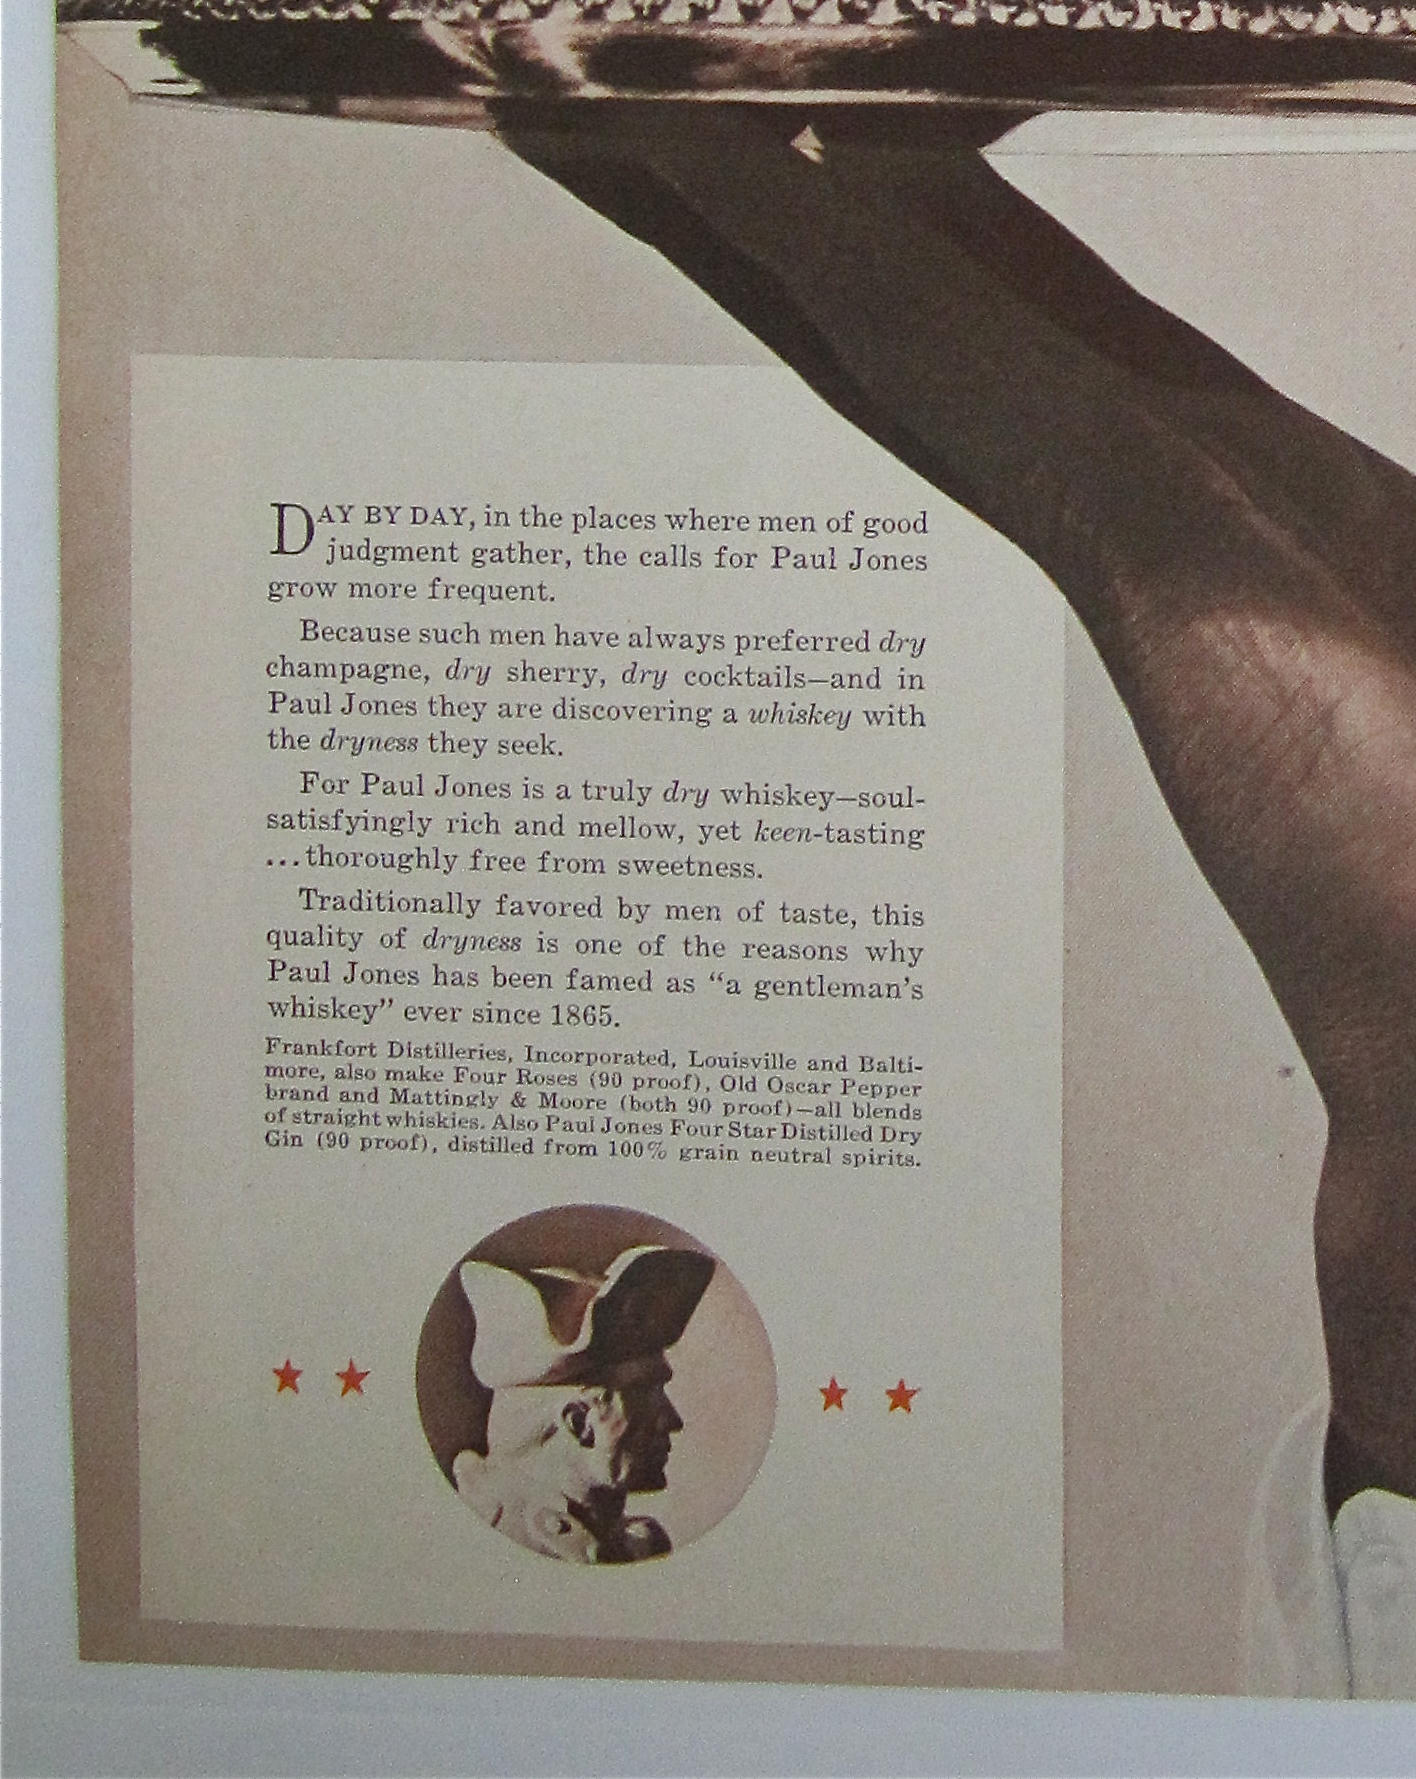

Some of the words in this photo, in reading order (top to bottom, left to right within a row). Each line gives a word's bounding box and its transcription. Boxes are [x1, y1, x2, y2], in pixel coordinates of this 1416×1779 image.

[270, 503, 354, 555] DAY
[365, 506, 402, 524] BY
[410, 506, 475, 531] DAY,
[484, 504, 510, 527] in
[520, 504, 563, 528] the
[572, 506, 656, 534] places
[664, 508, 750, 531] where
[759, 516, 816, 532] men
[826, 510, 855, 533] of
[863, 510, 928, 539] good
[326, 537, 459, 566] judgment
[471, 541, 571, 569] gather,
[584, 542, 627, 566] the
[639, 544, 702, 568] calls
[715, 545, 758, 568] for
[771, 546, 837, 570] Paul
[849, 547, 927, 571] Jones
[268, 582, 337, 603] grow
[348, 582, 416, 598] more
[428, 577, 555, 605] frequent.
[300, 619, 410, 643] Because
[419, 622, 480, 644] such
[490, 629, 545, 645] men
[554, 623, 619, 647] have
[628, 626, 725, 654] always
[735, 629, 870, 656] preferred
[879, 630, 926, 658] dry
[266, 654, 430, 684] champagne,
[445, 657, 491, 686] dry
[507, 659, 605, 689] sherry,
[622, 661, 667, 690] dry
[898, 667, 925, 690] in
[268, 691, 331, 715] Paul
[340, 692, 417, 716] Jones
[428, 694, 487, 722] they
[498, 703, 542, 718] are
[553, 697, 712, 728] discovering
[723, 708, 738, 723] a
[749, 701, 852, 731] whiskey
[863, 704, 926, 727] with
[267, 727, 310, 750] the
[320, 727, 418, 756] dryness
[428, 731, 488, 759] they
[498, 733, 563, 756] seek.
[300, 771, 350, 794] For
[361, 772, 424, 796] Paul
[434, 775, 511, 799] Jones
[523, 777, 544, 799] is
[556, 784, 571, 800] a
[582, 779, 652, 807] truly
[663, 780, 709, 809] dry
[267, 808, 432, 838] satisfyingly
[447, 812, 500, 834] rich
[515, 814, 565, 836] and
[579, 815, 684, 844] mellow,
[698, 821, 741, 845] yet
[754, 819, 925, 850] keen-tasting
[469, 848, 526, 872] free
[538, 850, 605, 874] from
[618, 855, 762, 879] sweetness.
[299, 887, 481, 919] Traditionally
[496, 894, 602, 918] favored
[617, 896, 651, 924] by
[666, 905, 721, 921] men
[737, 900, 765, 922] of
[780, 902, 856, 929] taste,
[872, 903, 924, 926] this
[267, 924, 363, 952] quality
[380, 927, 407, 949] of
[423, 927, 521, 955] dryness
[537, 931, 558, 953] is
[576, 939, 622, 955] one
[638, 934, 666, 956] of
[683, 935, 725, 957] the
[743, 943, 848, 961] reasons
[865, 939, 924, 968] why
[268, 959, 330, 983] Paul
[343, 961, 419, 985] Jones
[433, 963, 479, 987] has
[491, 965, 552, 989] been
[566, 968, 652, 991] famed
[667, 978, 695, 993] as
[754, 974, 923, 1001] gentleman’s
[404, 1006, 462, 1022] ever
[472, 1001, 540, 1025] since
[552, 1004, 620, 1027] 1865.
[266, 1037, 377, 1058] Frankfort
[388, 1041, 512, 1063] Distilleries,
[525, 1045, 676, 1069] Incorporated,
[689, 1050, 796, 1070] Louisville
[807, 1055, 847, 1072] and
[859, 1056, 923, 1074] Balti-
[265, 1066, 325, 1081] more,
[335, 1063, 376, 1080] also
[385, 1065, 444, 1082] make
[454, 1066, 507, 1084] Four
[516, 1068, 577, 1086] Roses
[590, 1072, 622, 1088] (90
[633, 1074, 710, 1092] proof),
[720, 1075, 756, 1092] Old
[767, 1076, 831, 1094] Oscar
[841, 1078, 922, 1099] Pepper
[265, 1083, 329, 1102] brand
[340, 1087, 378, 1104] and
[390, 1087, 498, 1109] Mattingly
[510, 1091, 526, 1108] &
[539, 1092, 606, 1110] Moore
[621, 1095, 676, 1112] (both
[688, 1098, 711, 1114] 90
[853, 1102, 922, 1120] blends
[265, 1107, 287, 1123] of
[293, 1108, 381, 1128] straight
[386, 1111, 485, 1129] whiskies.
[492, 1114, 538, 1131] Also
[546, 1115, 594, 1133] Paul
[601, 1117, 663, 1135] Jones
[671, 1119, 723, 1137] Four
[728, 1121, 776, 1139] Star
[781, 1123, 872, 1142] Distilled
[881, 1126, 922, 1146] Dry
[265, 1130, 303, 1147] Gin
[317, 1131, 349, 1150] (90
[360, 1133, 437, 1153] proof),
[448, 1135, 534, 1154] distilled
[545, 1138, 598, 1156] from
[609, 1141, 666, 1159] 100%
[679, 1144, 738, 1161] grain
[751, 1147, 831, 1164] neutral
[842, 1148, 921, 1167] spirits.
